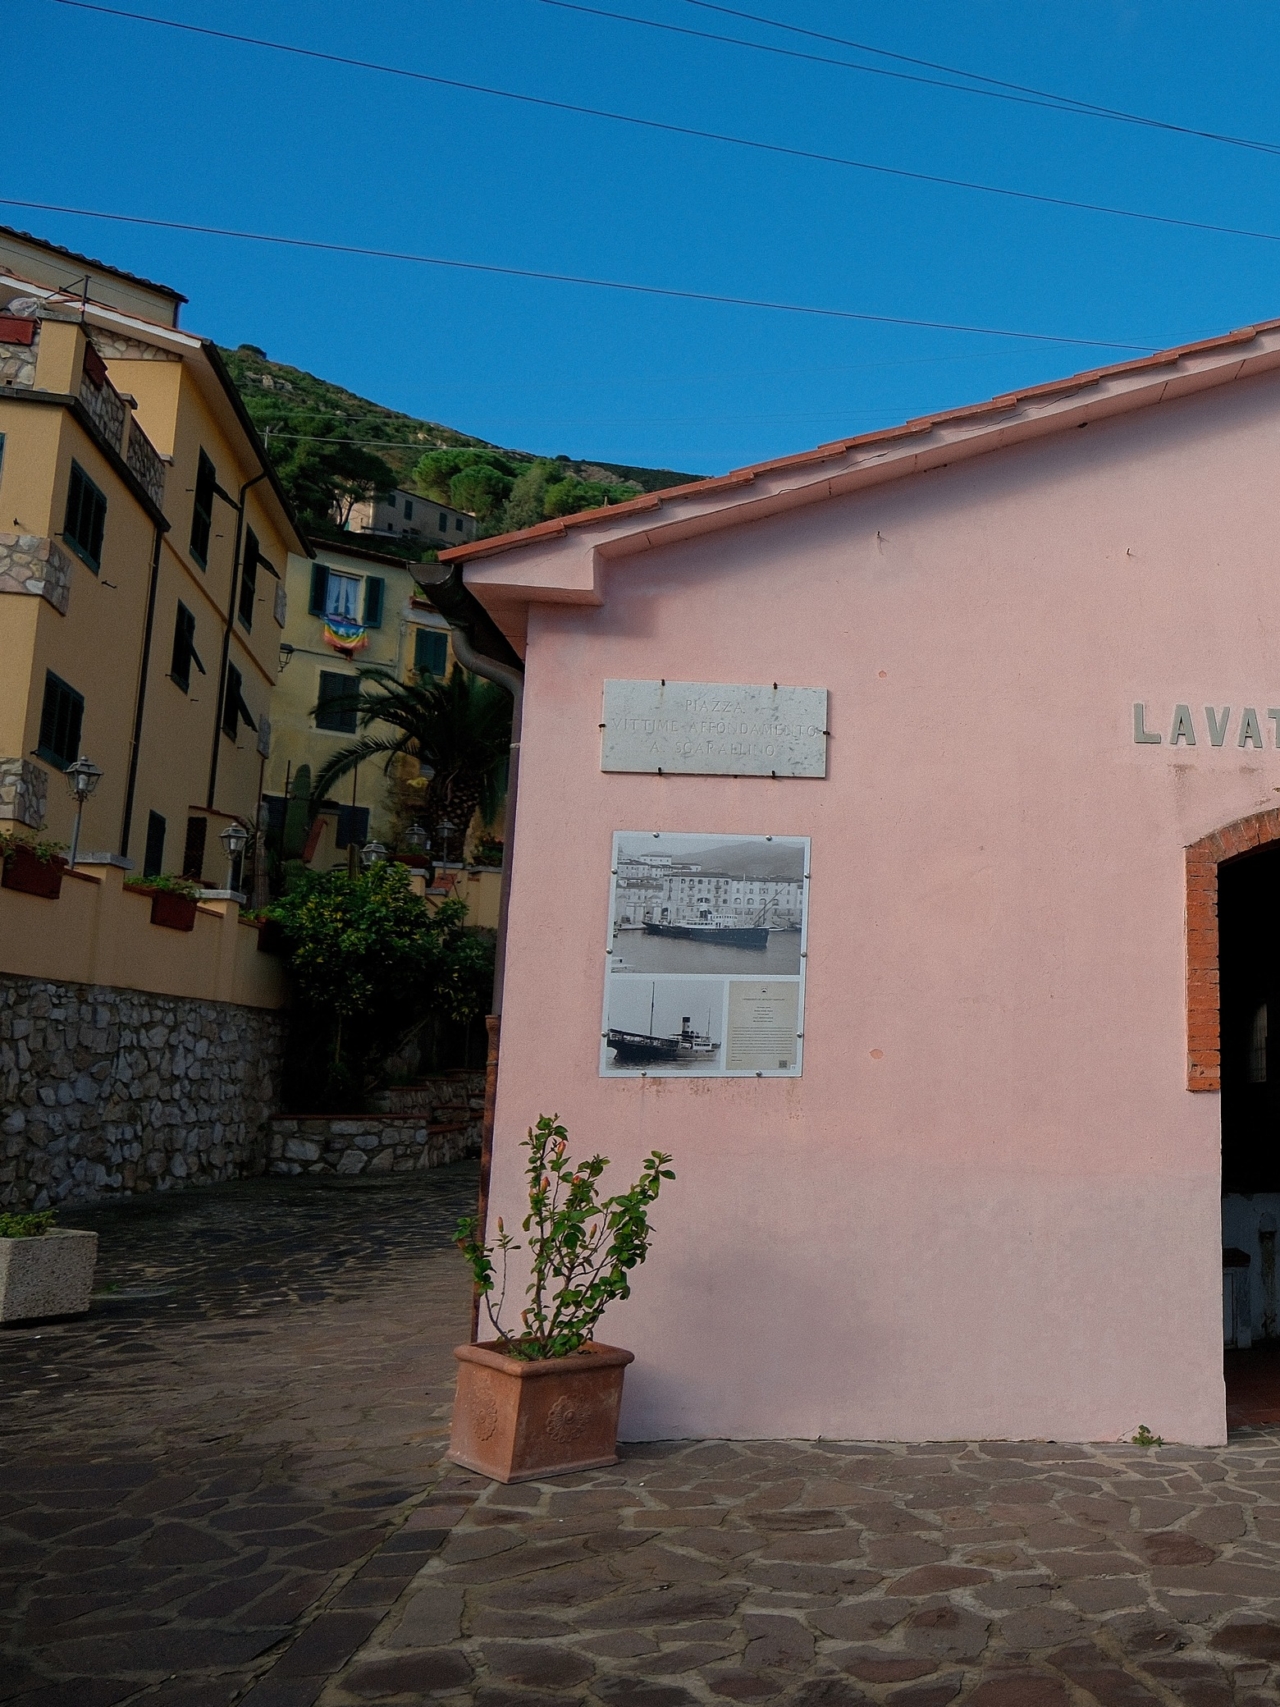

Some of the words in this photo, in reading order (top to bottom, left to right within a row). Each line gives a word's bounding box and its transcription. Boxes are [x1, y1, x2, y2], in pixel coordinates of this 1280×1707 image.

[685, 700, 743, 713] PIAZZA
[612, 718, 679, 732] VITTIME
[689, 721, 817, 737] AFFONDAMENTO
